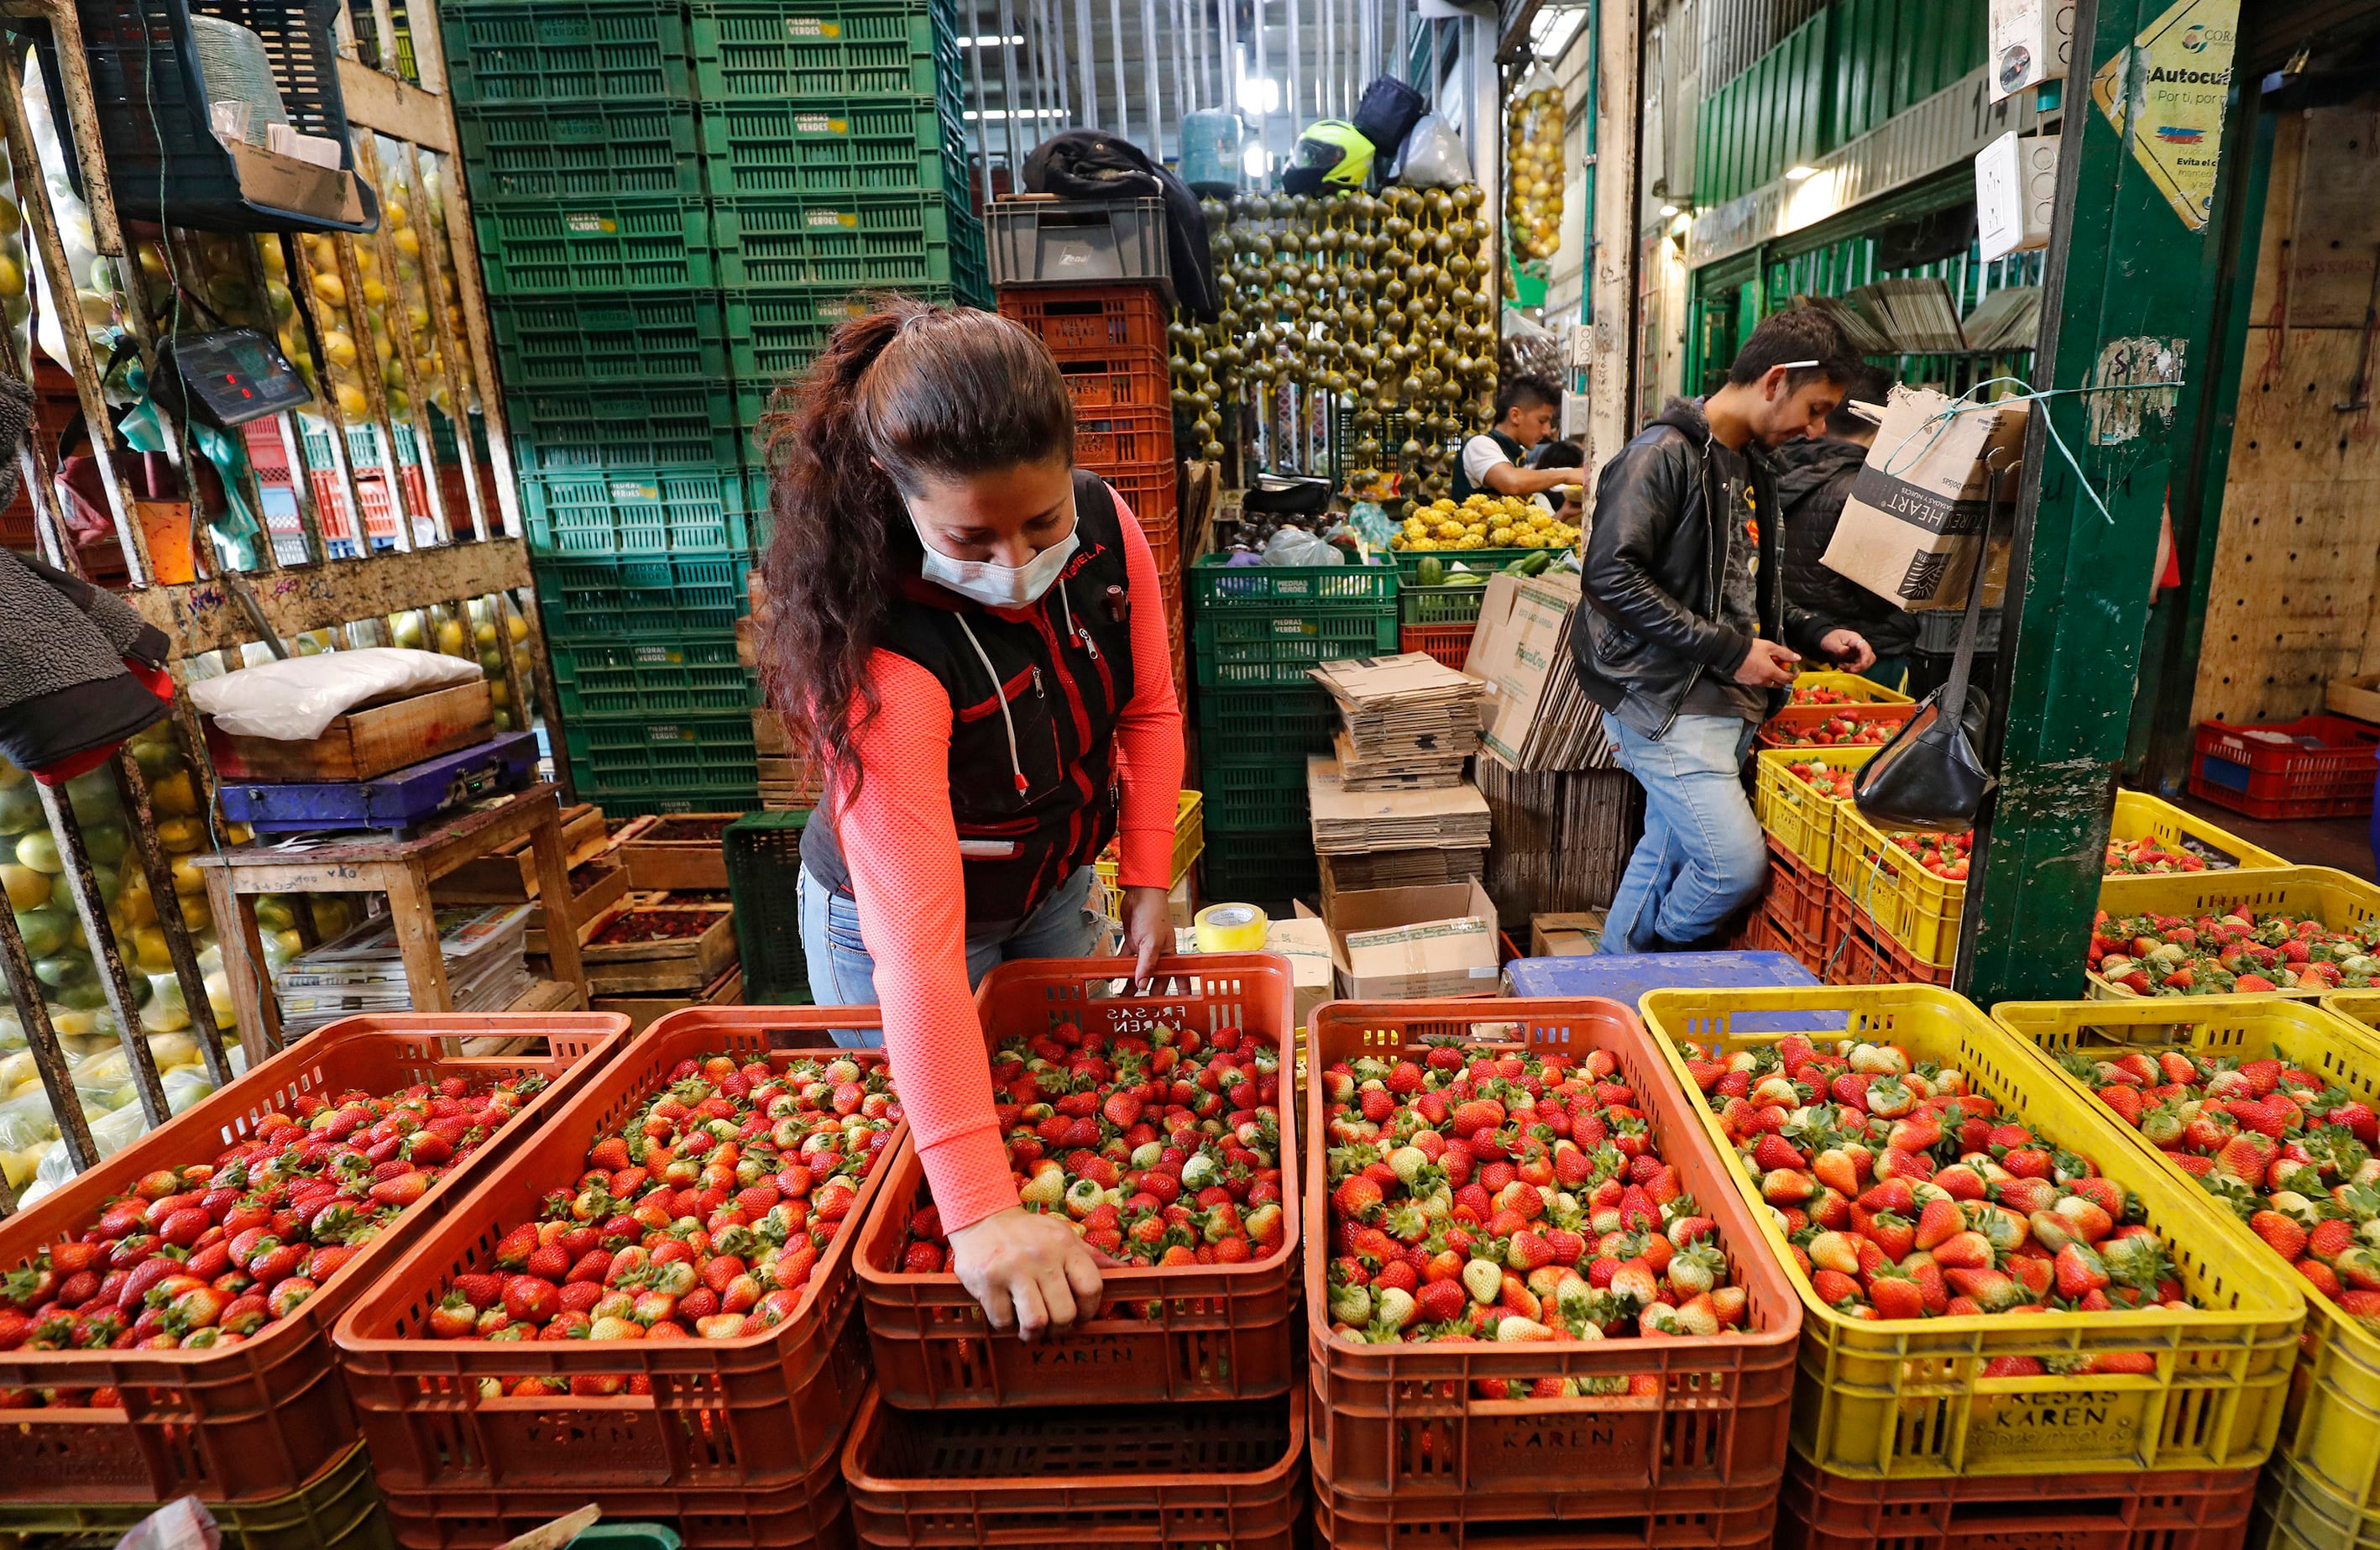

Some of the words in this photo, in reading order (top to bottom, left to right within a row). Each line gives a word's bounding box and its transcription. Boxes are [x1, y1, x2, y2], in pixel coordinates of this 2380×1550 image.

[789, 26, 820, 35] VERDES
[2205, 30, 2235, 42] COR
[2158, 90, 2179, 102] Por
[2195, 94, 2218, 105] por
[797, 123, 829, 131] VERDES
[2177, 157, 2200, 166] Evita
[808, 217, 839, 225] VERDES
[569, 222, 600, 231] VERDES
[1942, 477, 1962, 491] bolsas
[611, 490, 641, 498] VERDES
[1274, 626, 1301, 634] VERDES
[637, 653, 666, 662] VERDES
[651, 731, 678, 740] VERDES
[1032, 1346, 1133, 1365] KAREN
[1996, 1407, 2107, 1427] KAREN
[1502, 1428, 1614, 1448] KAREN
